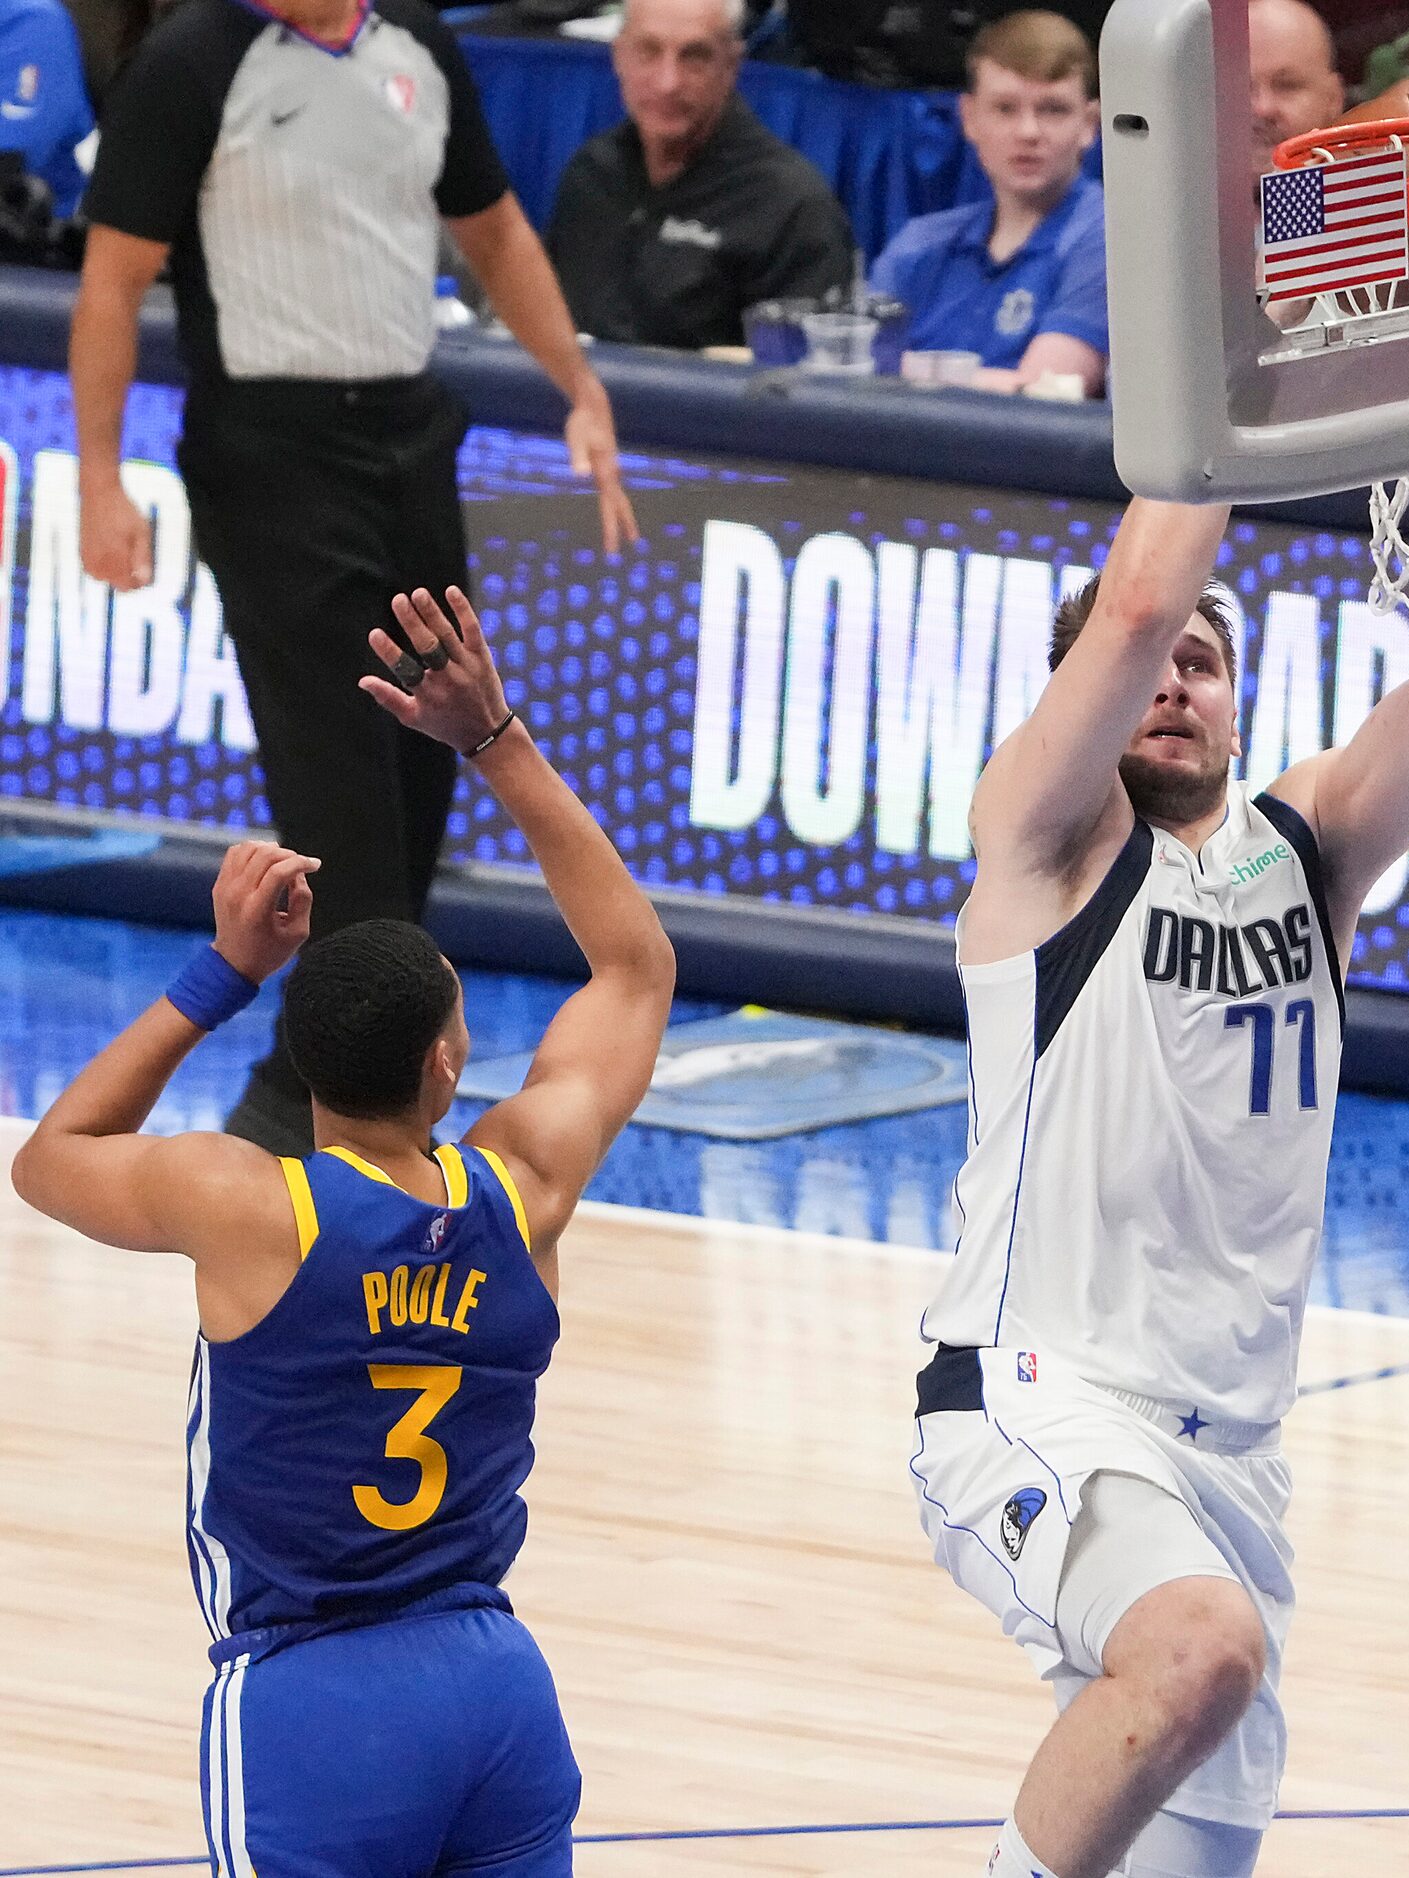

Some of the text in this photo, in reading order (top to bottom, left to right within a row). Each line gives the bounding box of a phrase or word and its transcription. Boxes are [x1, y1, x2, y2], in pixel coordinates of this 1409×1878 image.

[22, 449, 259, 753] NBA
[1143, 902, 1313, 1000] DALLAS
[1223, 997, 1319, 1117] 77
[362, 1262, 488, 1335] POOLE
[351, 1363, 463, 1531] 3
